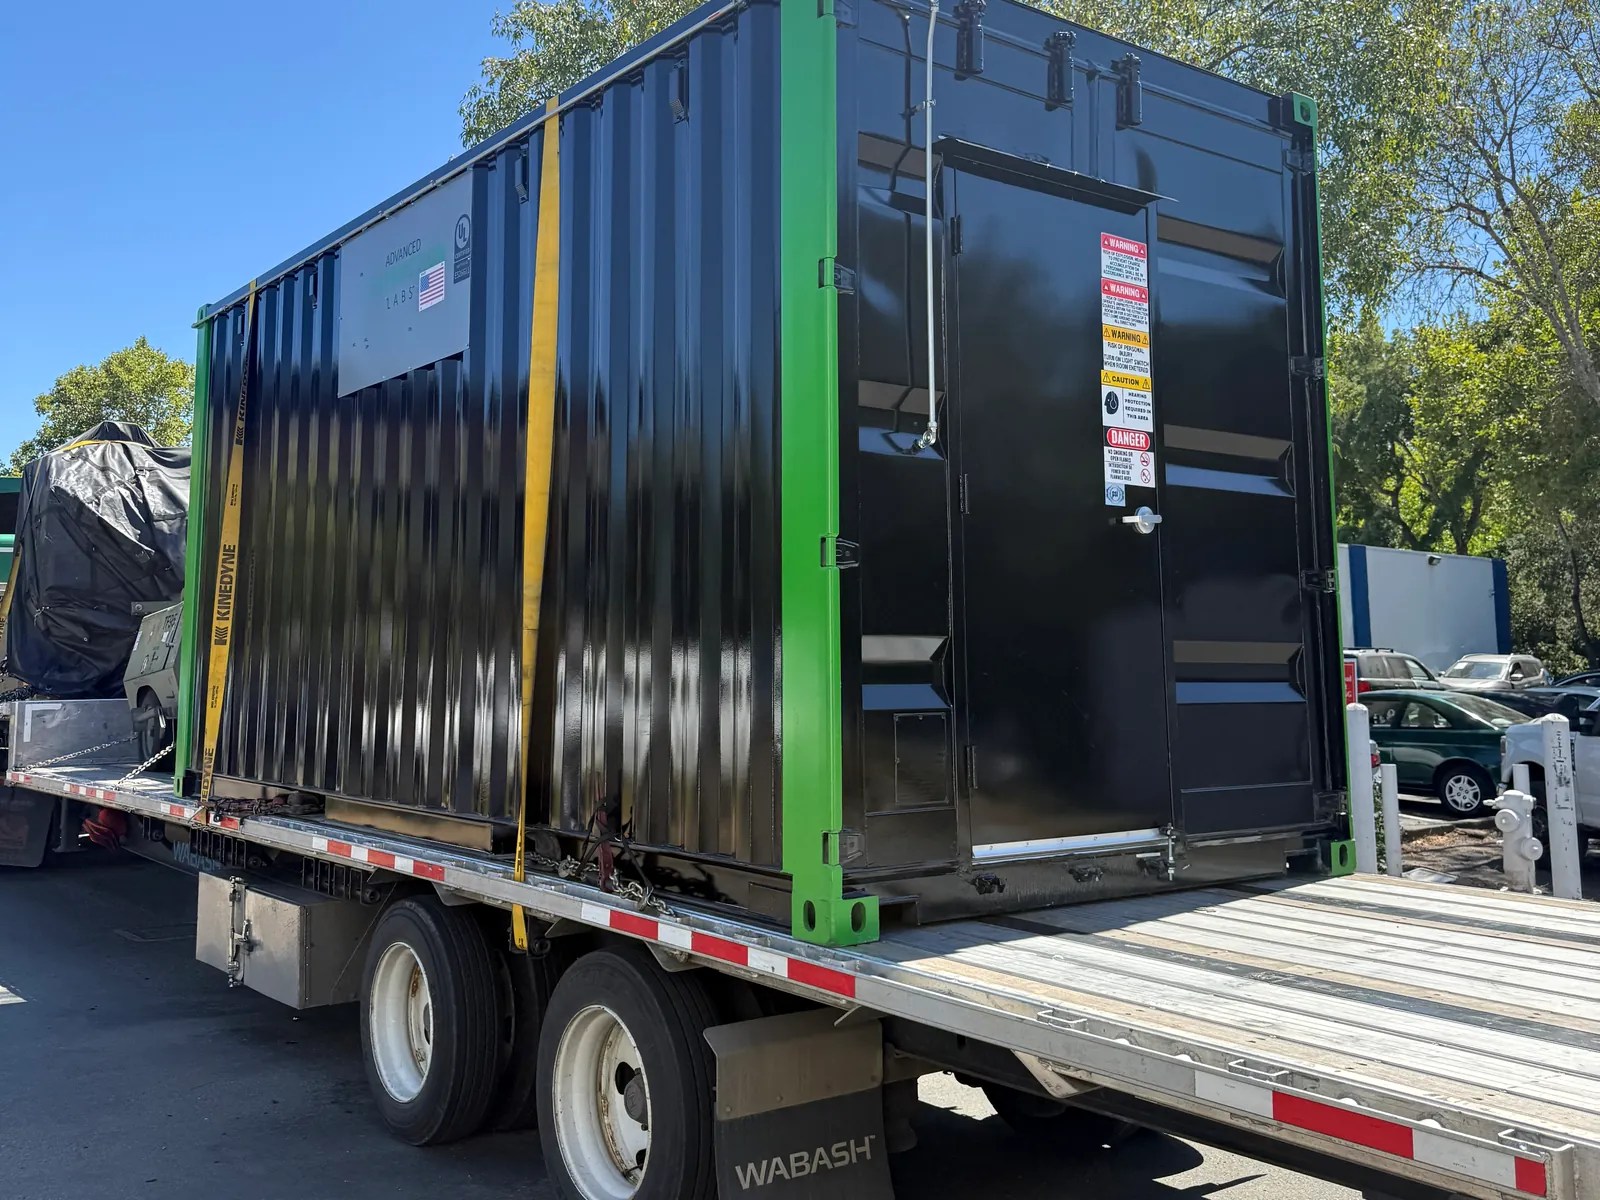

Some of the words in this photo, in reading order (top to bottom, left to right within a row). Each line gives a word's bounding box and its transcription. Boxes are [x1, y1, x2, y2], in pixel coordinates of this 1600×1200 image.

[385, 239, 421, 267] ADVANCED
[1109, 238, 1139, 253] WARNING
[385, 286, 413, 309] LABS
[1110, 284, 1140, 298] WARNING
[1111, 330, 1141, 343] WARNING
[1124, 345, 1145, 354] PERSONAL
[1112, 376, 1139, 385] CAUTION
[1111, 430, 1146, 448] DANGER
[216, 544, 236, 621] KINEDYNE
[201, 748, 214, 801] EDYNE
[735, 1136, 872, 1190] WABASH
